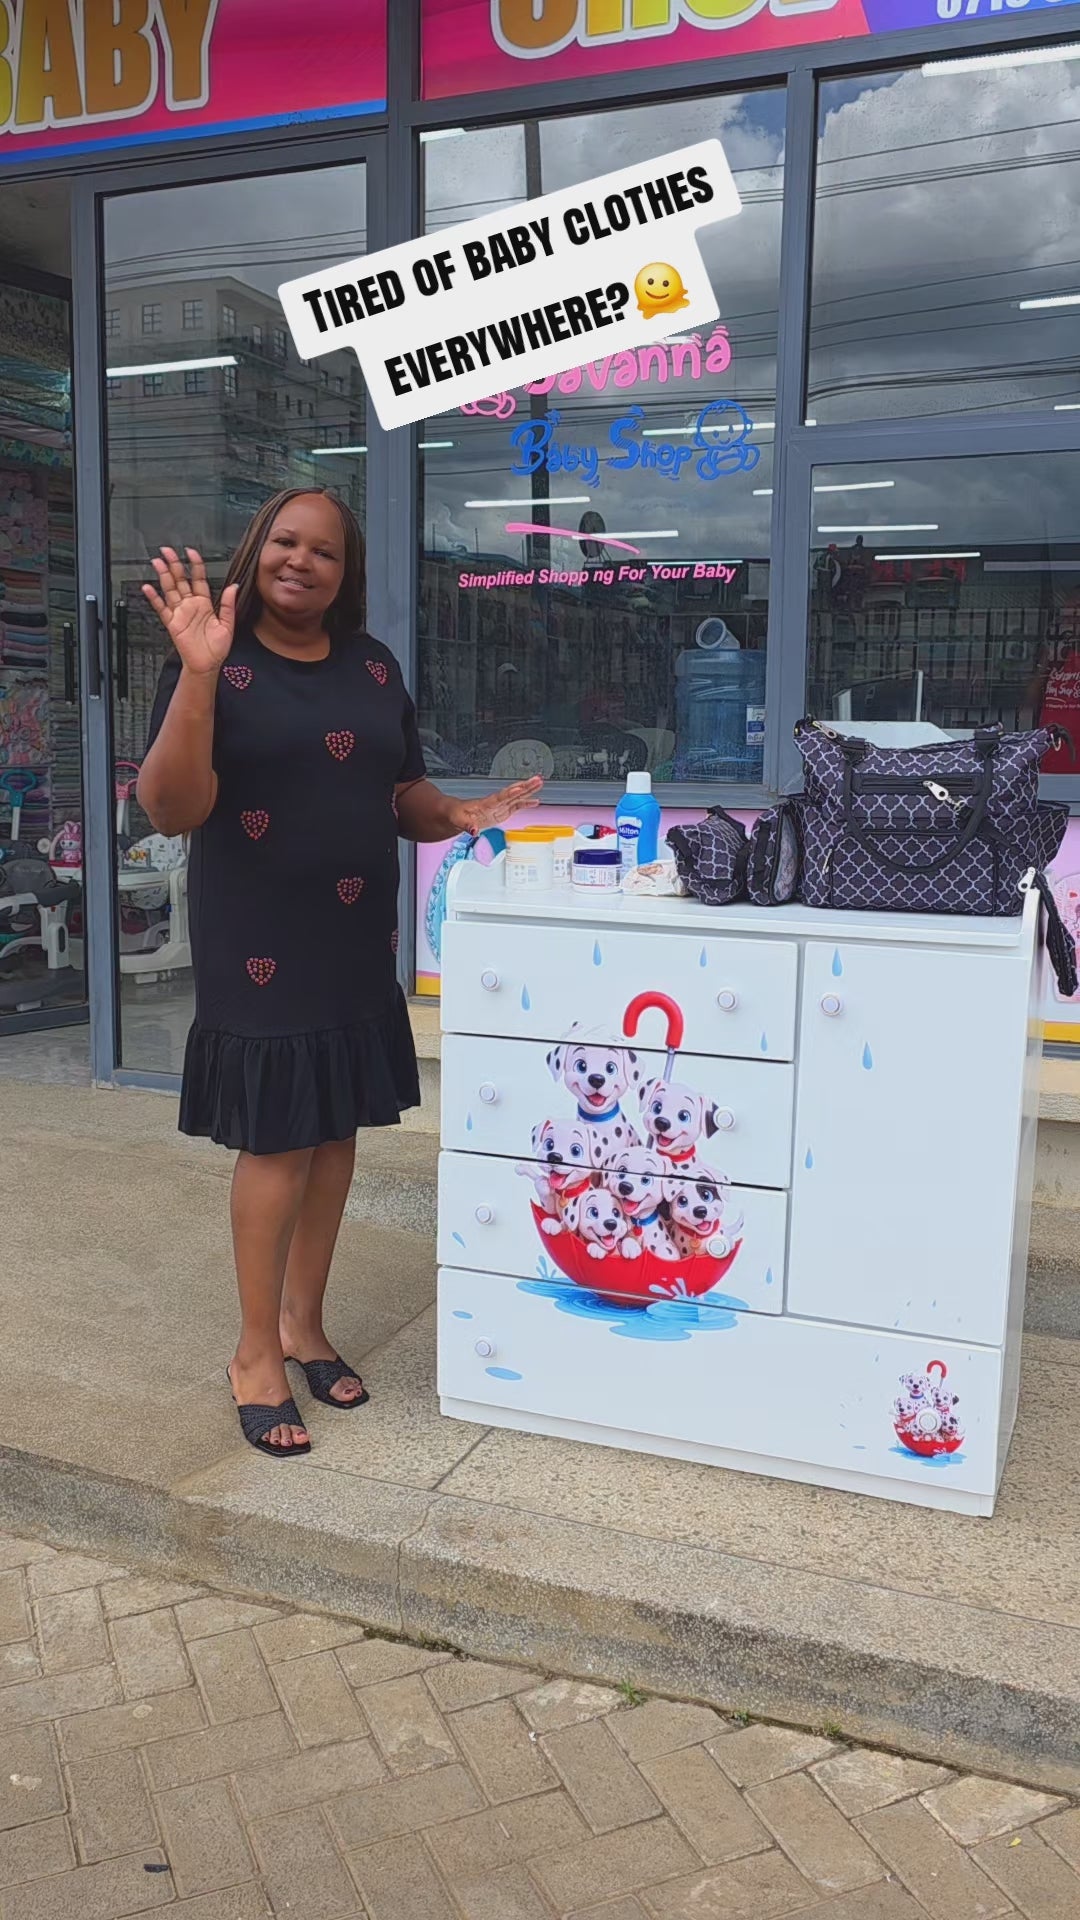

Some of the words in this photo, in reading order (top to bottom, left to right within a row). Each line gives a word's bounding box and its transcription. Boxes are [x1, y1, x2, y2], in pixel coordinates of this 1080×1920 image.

[0, 0, 217, 133] ABY
[510, 412, 599, 486] Baby
[606, 408, 692, 479] Shop
[458, 570, 535, 590] Simplified
[618, 565, 646, 581] For
[651, 565, 690, 579] Your
[693, 561, 736, 584] Baby
[619, 827, 639, 836] Milton
